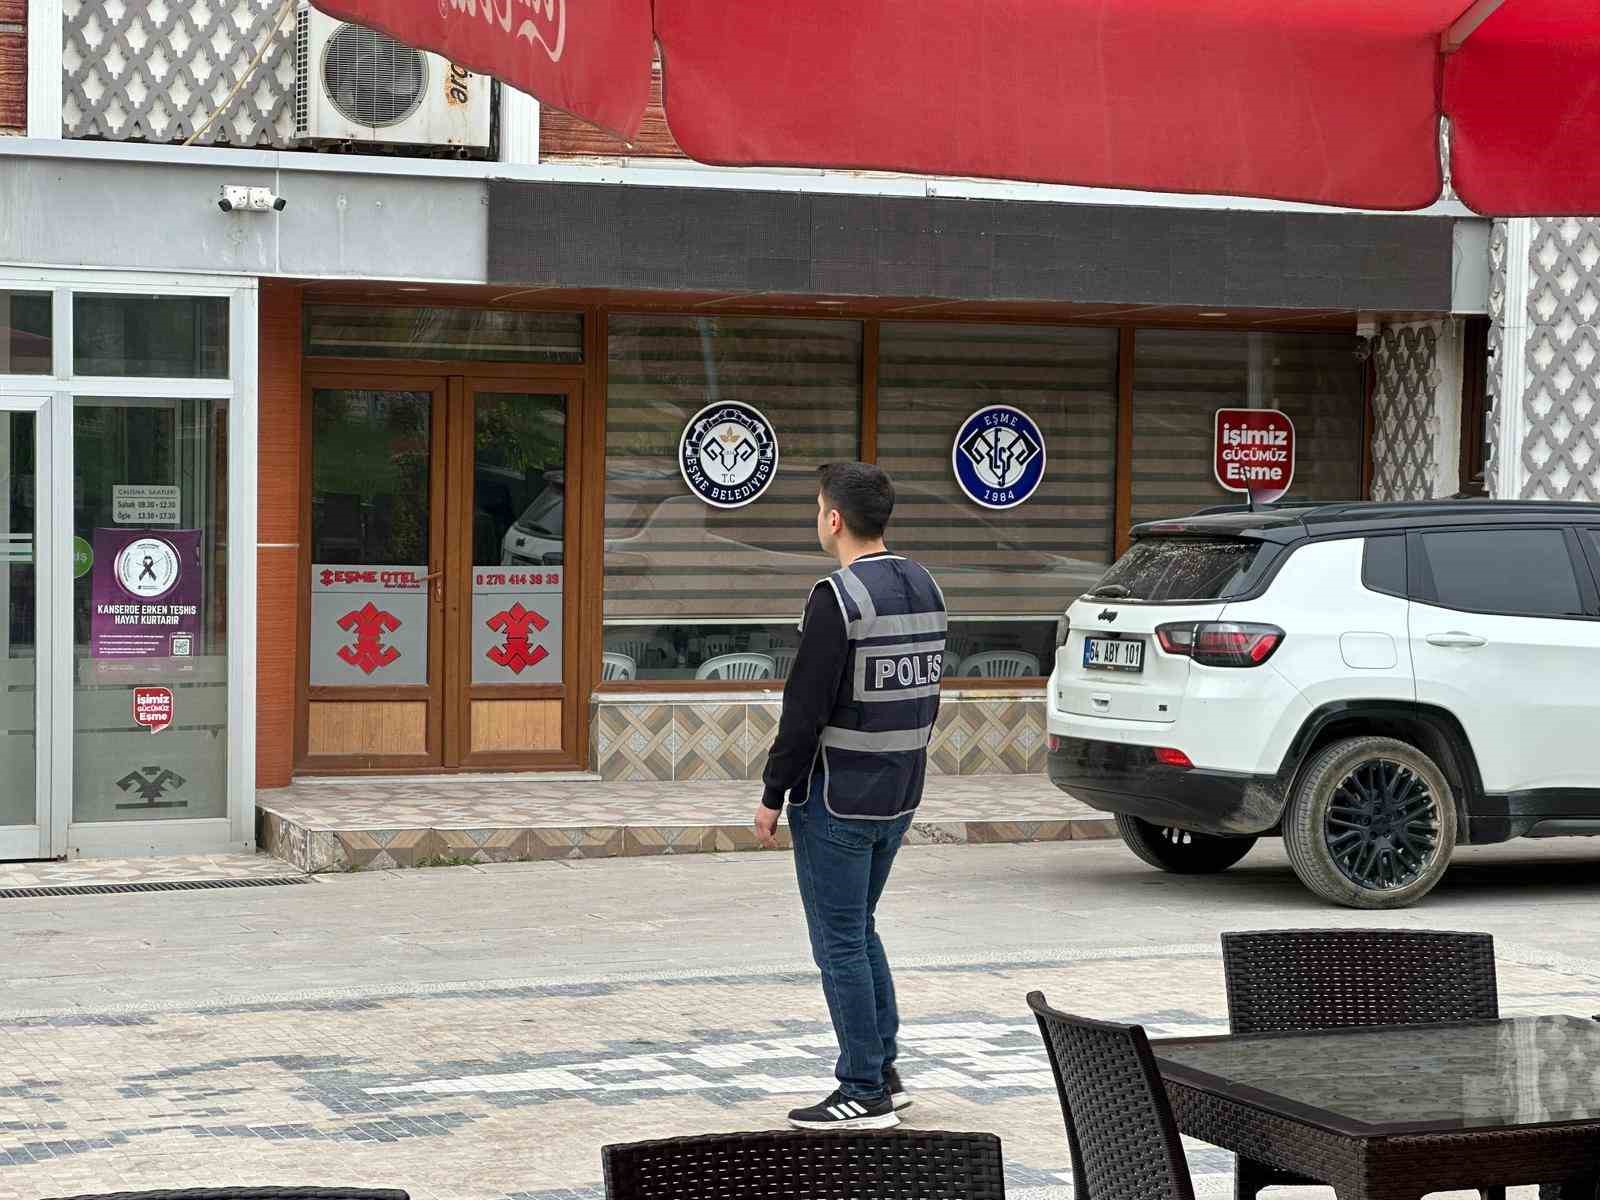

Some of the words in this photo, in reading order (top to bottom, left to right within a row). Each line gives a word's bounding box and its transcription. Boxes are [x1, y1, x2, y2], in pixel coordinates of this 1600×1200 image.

[984, 413, 1018, 427] EŞME
[1222, 446, 1288, 461] GÜCÜMÜZ
[687, 458, 709, 491] EŞME
[984, 489, 1015, 502] 1984
[477, 574, 484, 586] 0
[97, 604, 140, 615] KANSERDE
[142, 605, 168, 615] ERKEN
[114, 615, 140, 625] HAYAT
[141, 615, 180, 625] KURTARIR
[1089, 641, 1099, 661] 64
[1103, 642, 1120, 663] ABY
[1125, 644, 1140, 665] 101
[139, 712, 168, 721] Eşme
